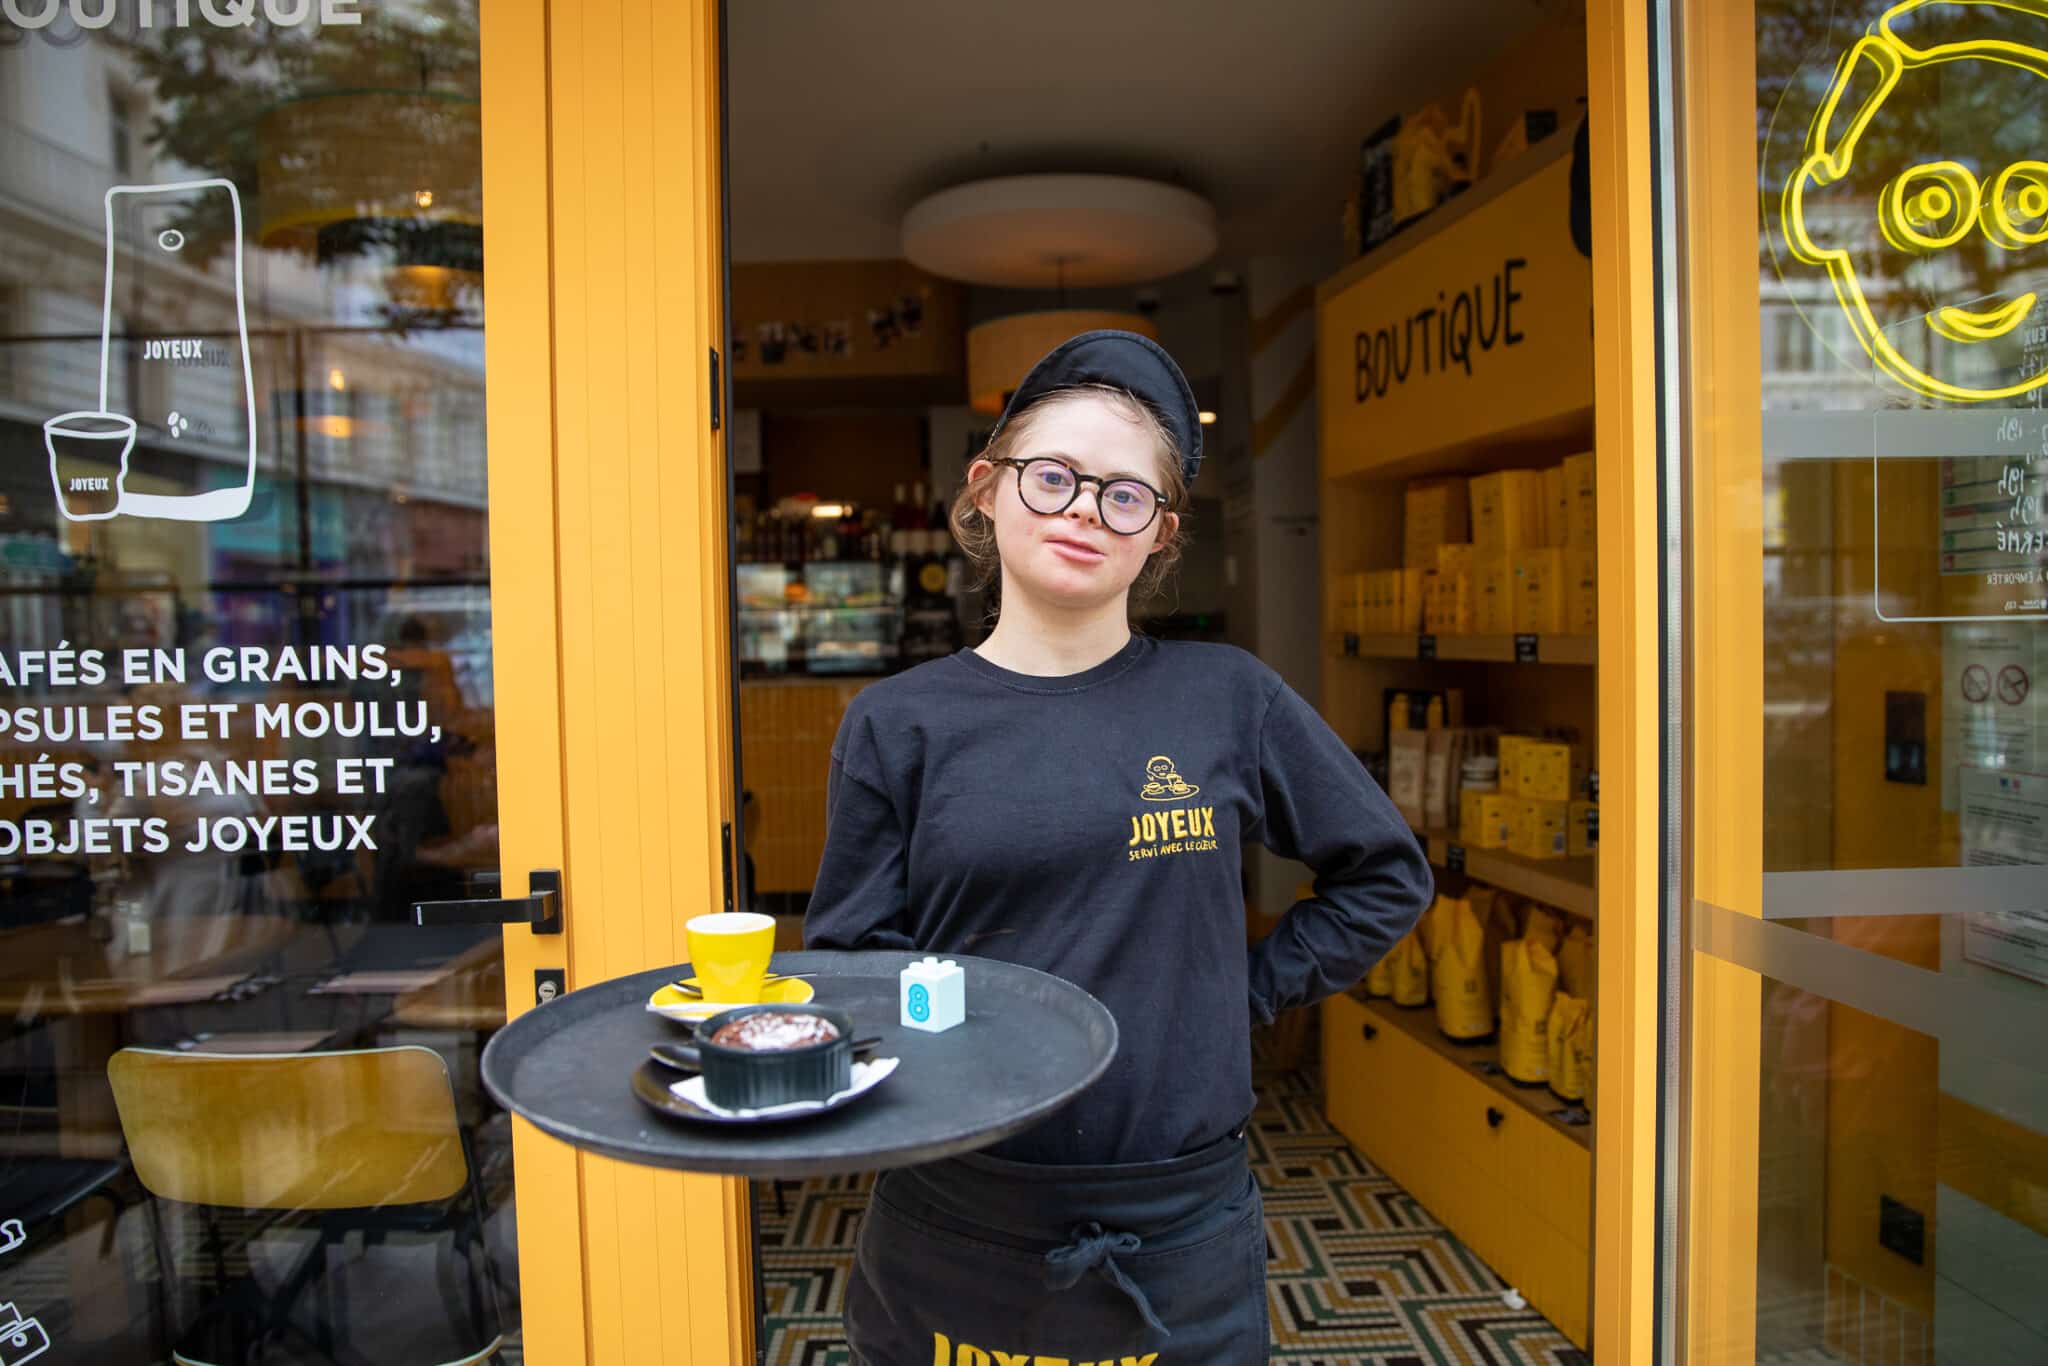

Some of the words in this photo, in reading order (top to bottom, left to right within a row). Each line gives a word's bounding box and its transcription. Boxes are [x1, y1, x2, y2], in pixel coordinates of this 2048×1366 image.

[144, 340, 203, 360] JOYEUX
[70, 478, 109, 491] JOYEUX
[123, 648, 186, 684] EN
[203, 644, 402, 687] GRAINS,
[180, 704, 239, 740] ET
[255, 700, 442, 744] MOULU,
[0, 753, 99, 805] HÉS,
[114, 759, 320, 797] TISANES
[336, 758, 394, 795] ET
[185, 815, 378, 854] JOYEUX
[1129, 807, 1215, 846] JOYEUX
[1160, 843, 1183, 855] AVEC
[1185, 841, 1195, 851] LE
[908, 983, 930, 1023] 8
